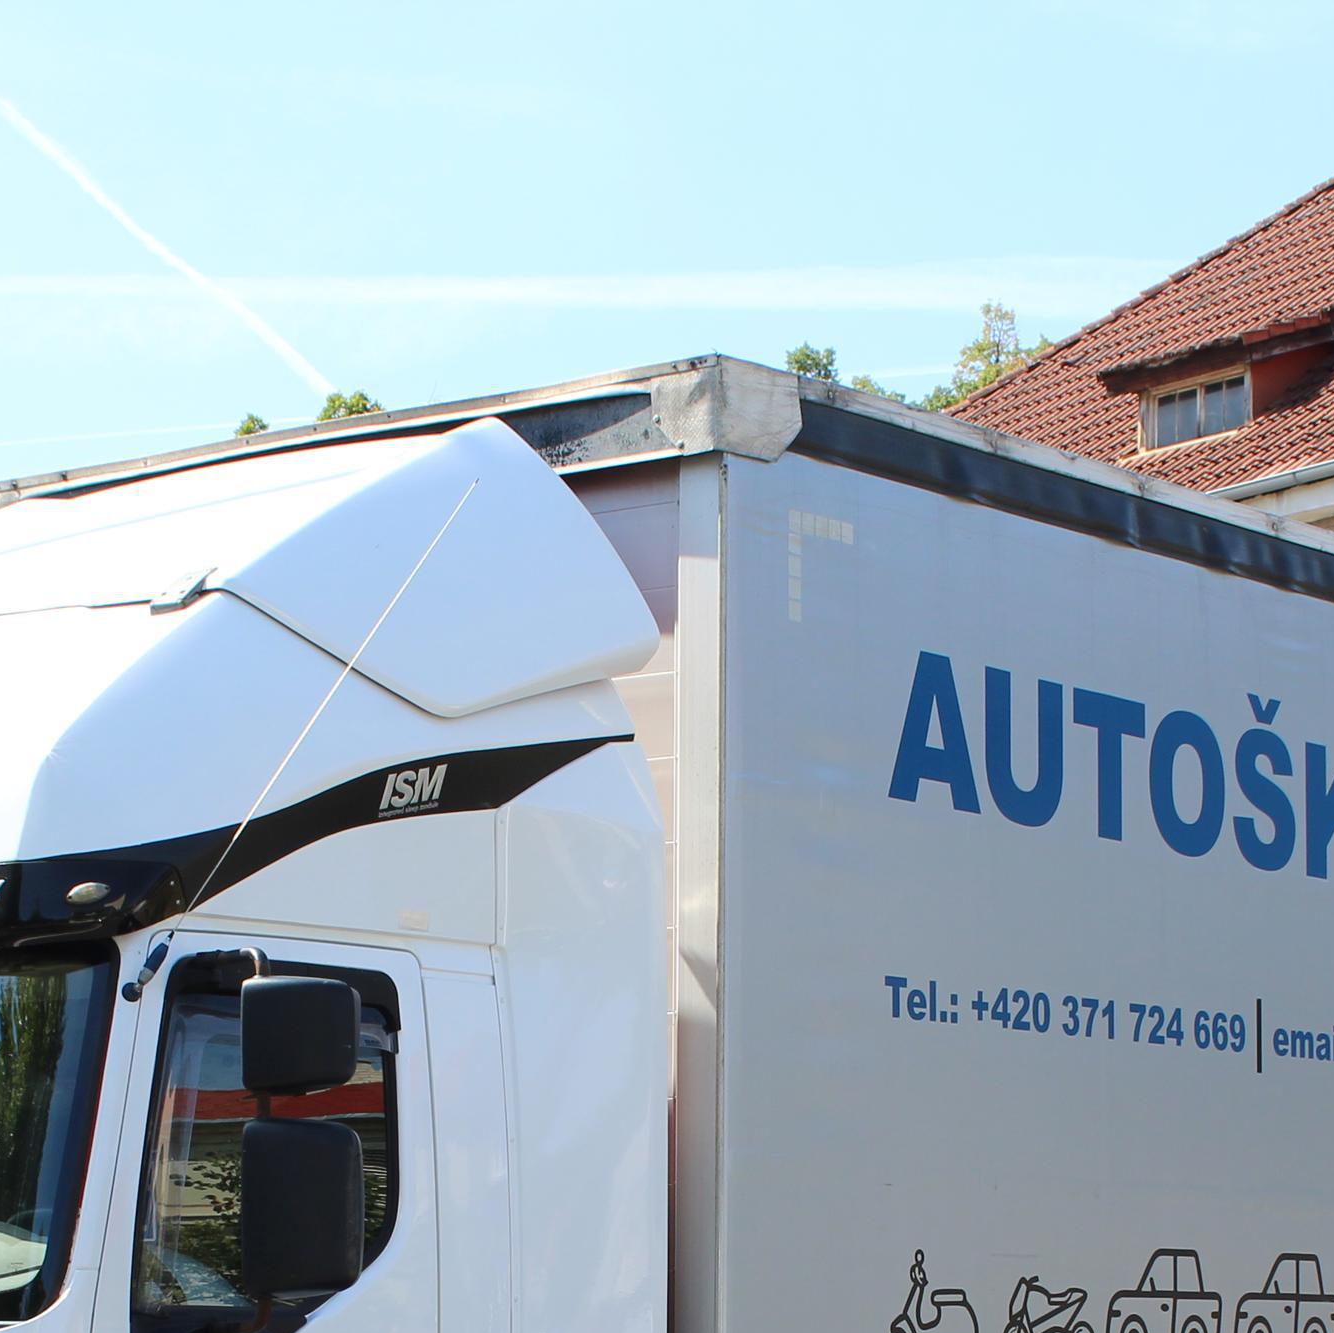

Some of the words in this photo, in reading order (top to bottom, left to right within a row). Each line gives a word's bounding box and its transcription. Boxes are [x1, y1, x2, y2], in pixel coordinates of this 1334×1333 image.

[378, 764, 448, 810] ISM
[884, 976, 959, 1023] Tel.:
[971, 988, 1051, 1034] +420
[1062, 995, 1116, 1040] 371
[1129, 1002, 1185, 1047] 724
[1194, 1010, 1247, 1053] 669
